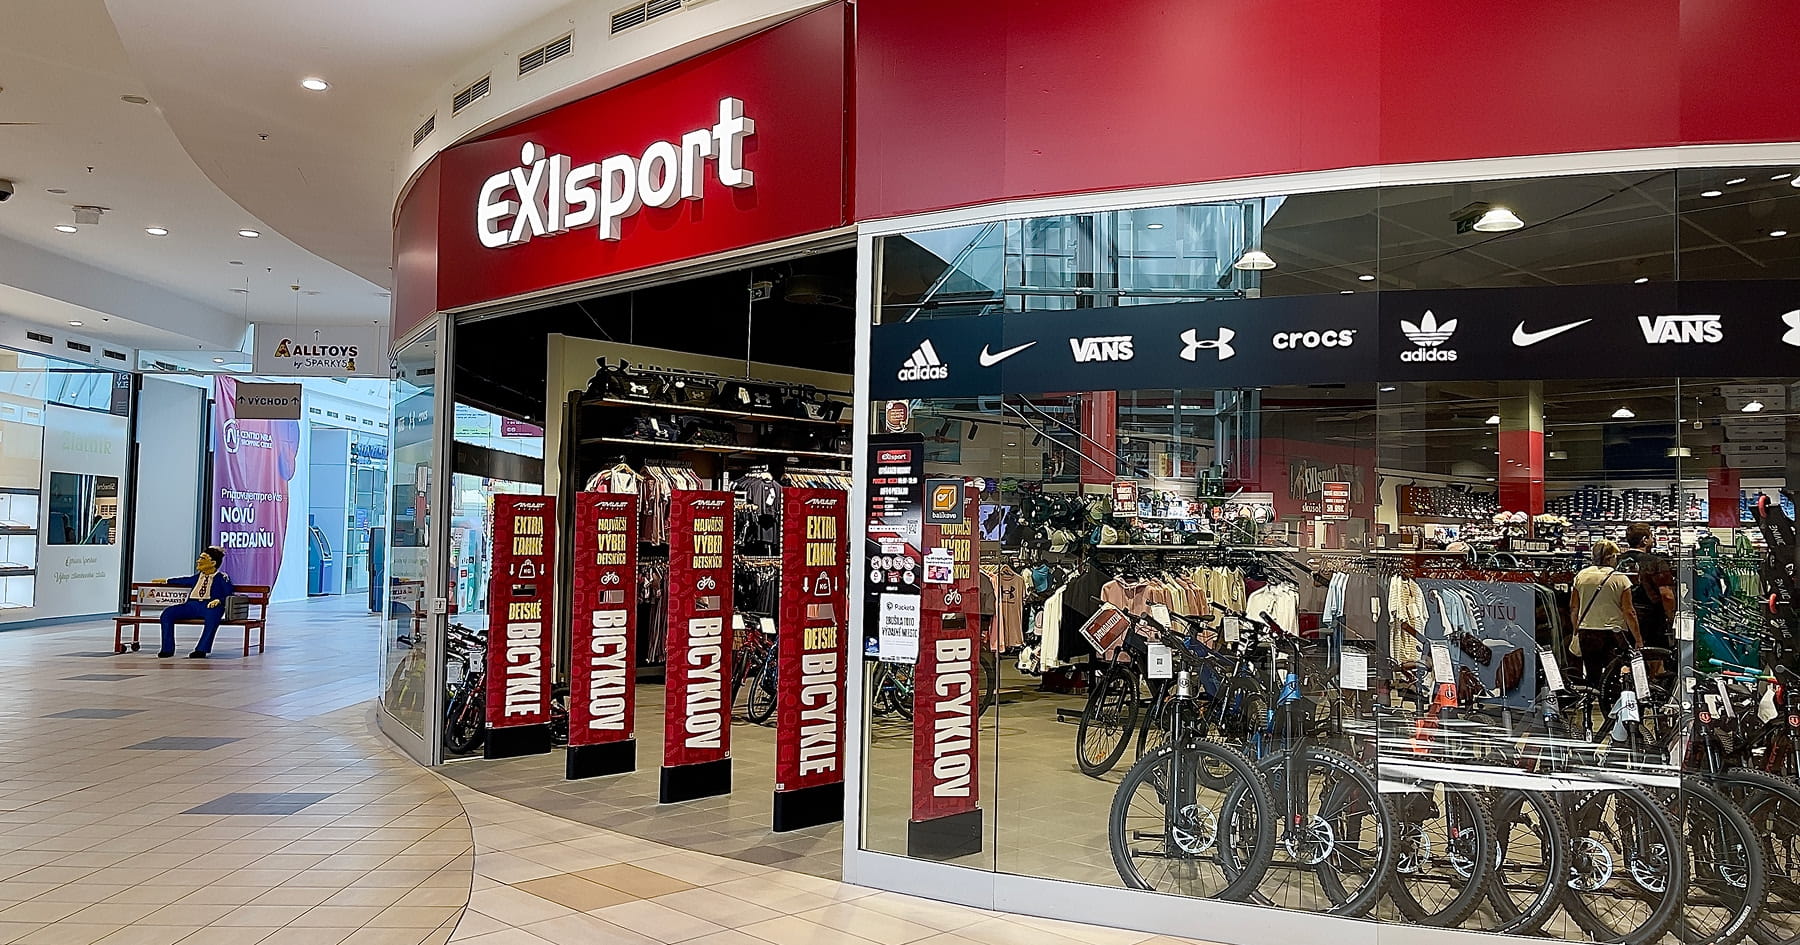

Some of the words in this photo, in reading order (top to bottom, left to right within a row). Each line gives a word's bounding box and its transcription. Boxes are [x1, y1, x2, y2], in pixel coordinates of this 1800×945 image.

[1272, 328, 1353, 350] crocs
[1637, 314, 1724, 344] VANS
[292, 345, 358, 357] ALLTOYS
[1069, 335, 1134, 363] VANS
[1400, 347, 1458, 363] adidas
[304, 358, 348, 368] SPARKYS
[898, 363, 948, 381] adidas
[248, 395, 289, 406] VÝCHOD
[221, 503, 255, 523] NOVÚ
[514, 516, 543, 535] EXTRA
[806, 516, 837, 540] EXTRA
[221, 528, 274, 548] PREDAJŇU
[597, 531, 626, 552] VÝBER
[693, 532, 723, 554] VÝBER
[508, 600, 542, 620] DETSKÉ
[504, 622, 542, 717] BICYKLE
[589, 609, 627, 730] BICYKLOV
[685, 617, 723, 748] BICYKLOV
[799, 652, 838, 777] BICYKLE
[933, 638, 972, 797] BICYKLOV
[1314, 753, 1354, 774] MAXXIS
